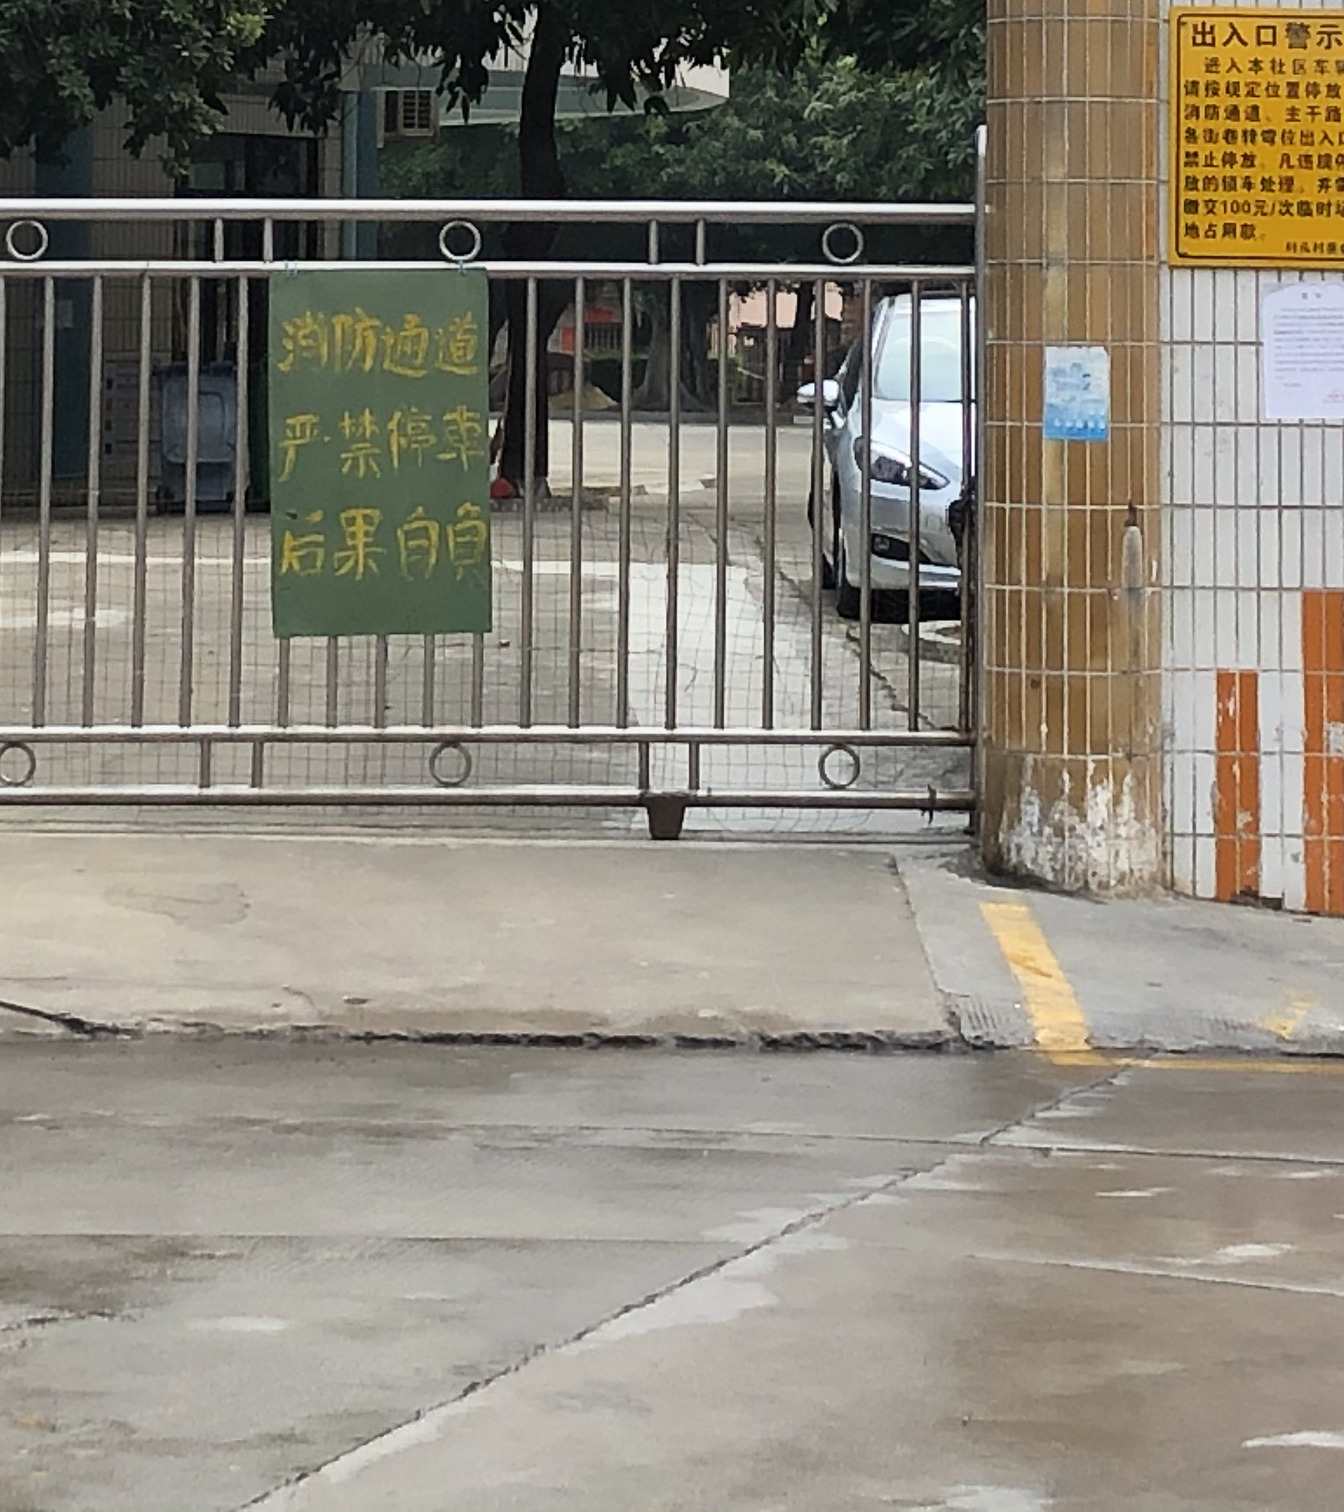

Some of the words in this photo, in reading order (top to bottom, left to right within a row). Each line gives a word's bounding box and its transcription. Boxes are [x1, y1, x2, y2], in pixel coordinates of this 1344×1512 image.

[1191, 21, 1343, 50] 出入口警示
[277, 306, 480, 378] 消防通道
